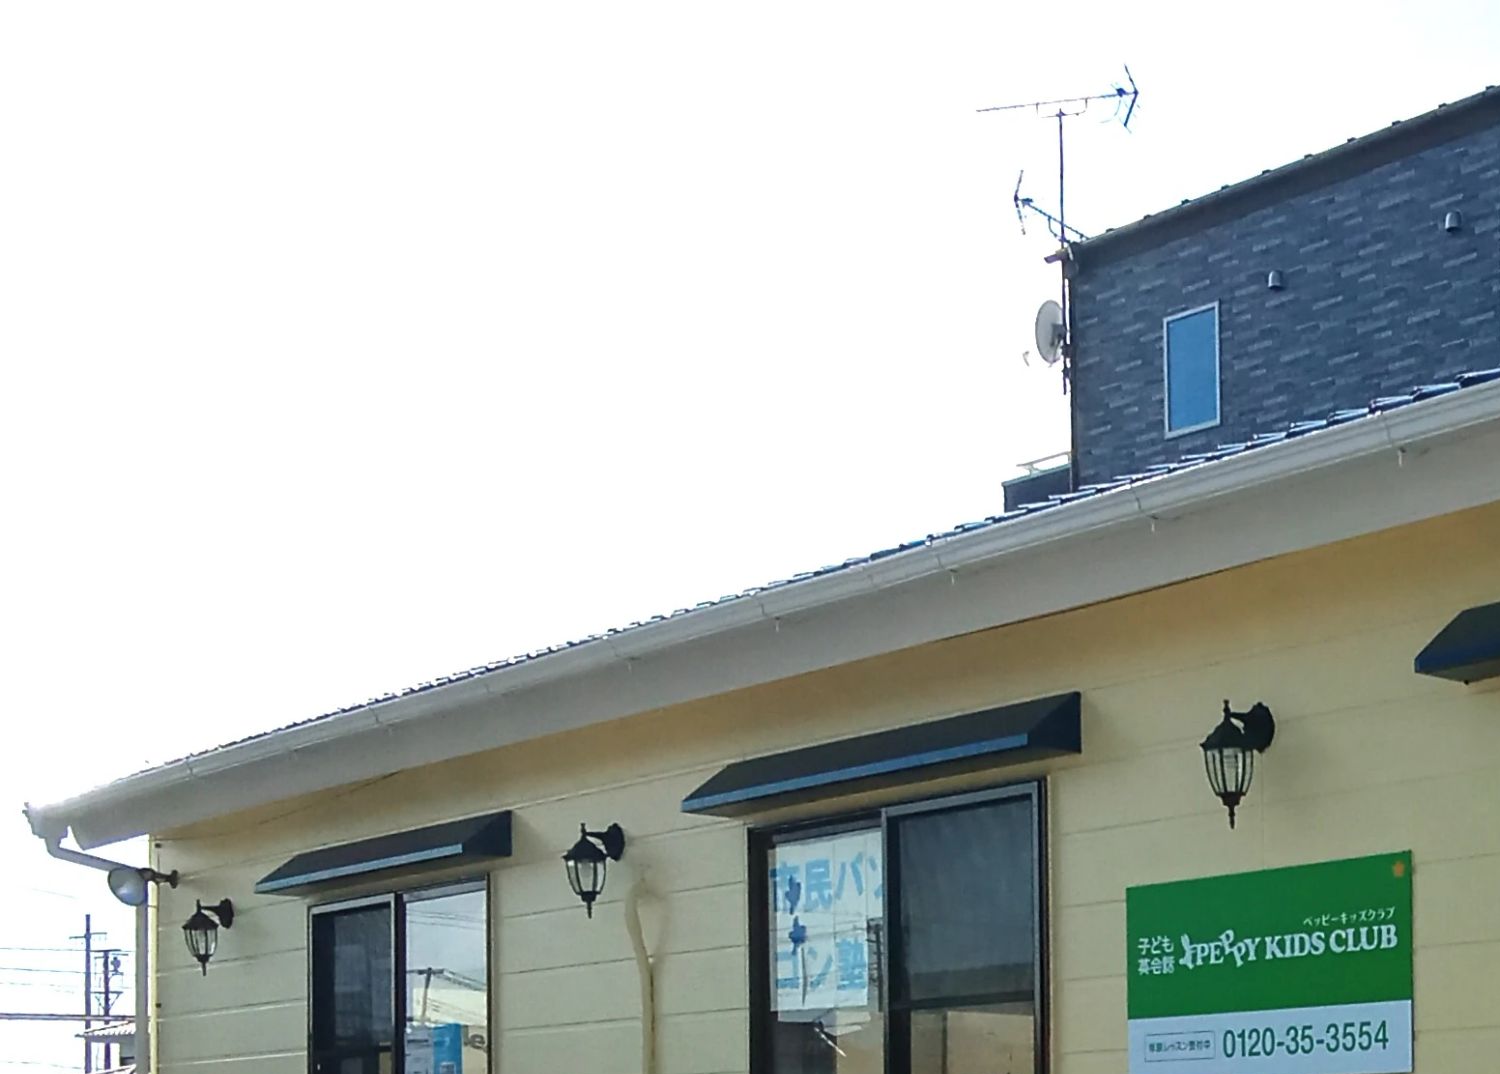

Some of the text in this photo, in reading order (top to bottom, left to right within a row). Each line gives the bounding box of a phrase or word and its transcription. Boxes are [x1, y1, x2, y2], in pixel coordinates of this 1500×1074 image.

[1138, 936, 1174, 955] 子ども
[1196, 924, 1398, 967] PEPPY KIDS CLUB
[1138, 956, 1175, 976] 英会話
[1222, 1020, 1389, 1058] 0120-35-3554
